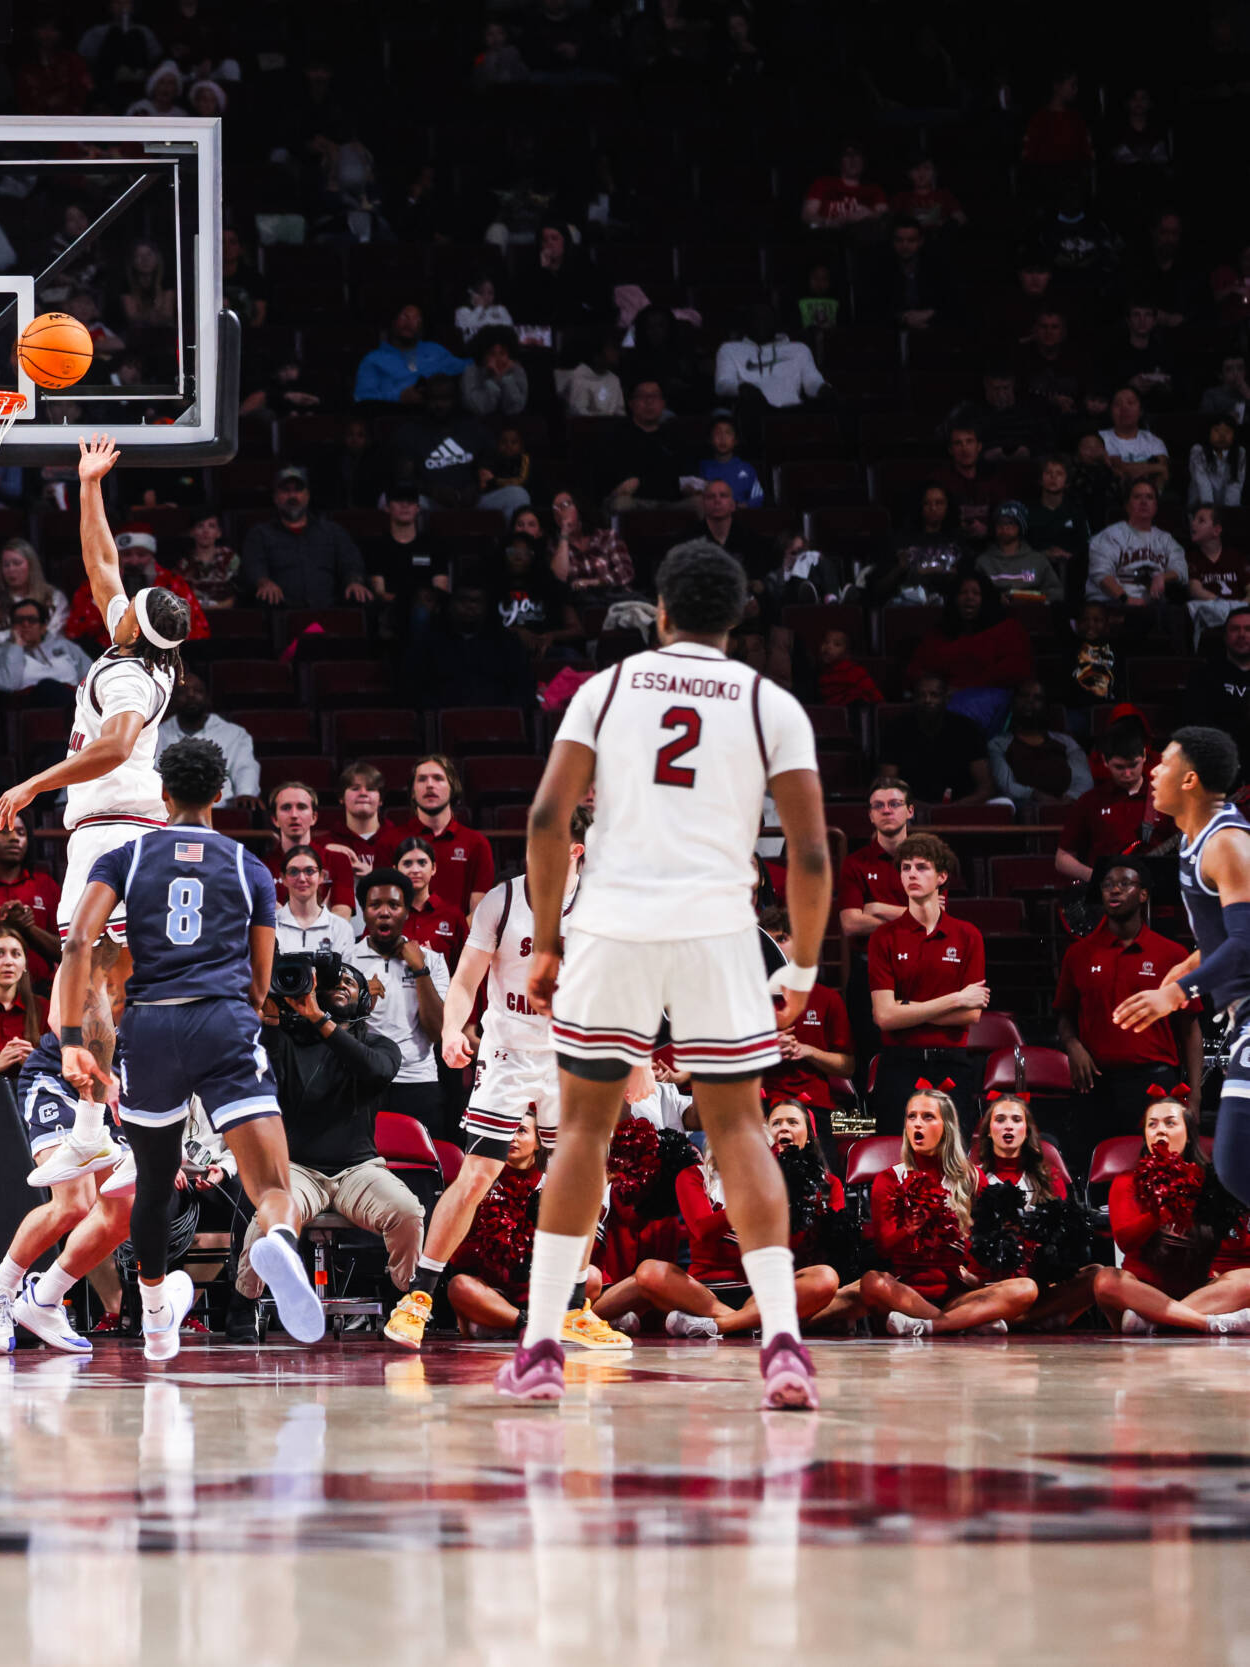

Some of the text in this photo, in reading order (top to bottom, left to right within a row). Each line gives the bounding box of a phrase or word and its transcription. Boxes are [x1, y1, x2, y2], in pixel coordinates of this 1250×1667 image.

[631, 672, 741, 701] ESSANDOKO
[653, 705, 703, 789] 2
[166, 877, 204, 945] 8
